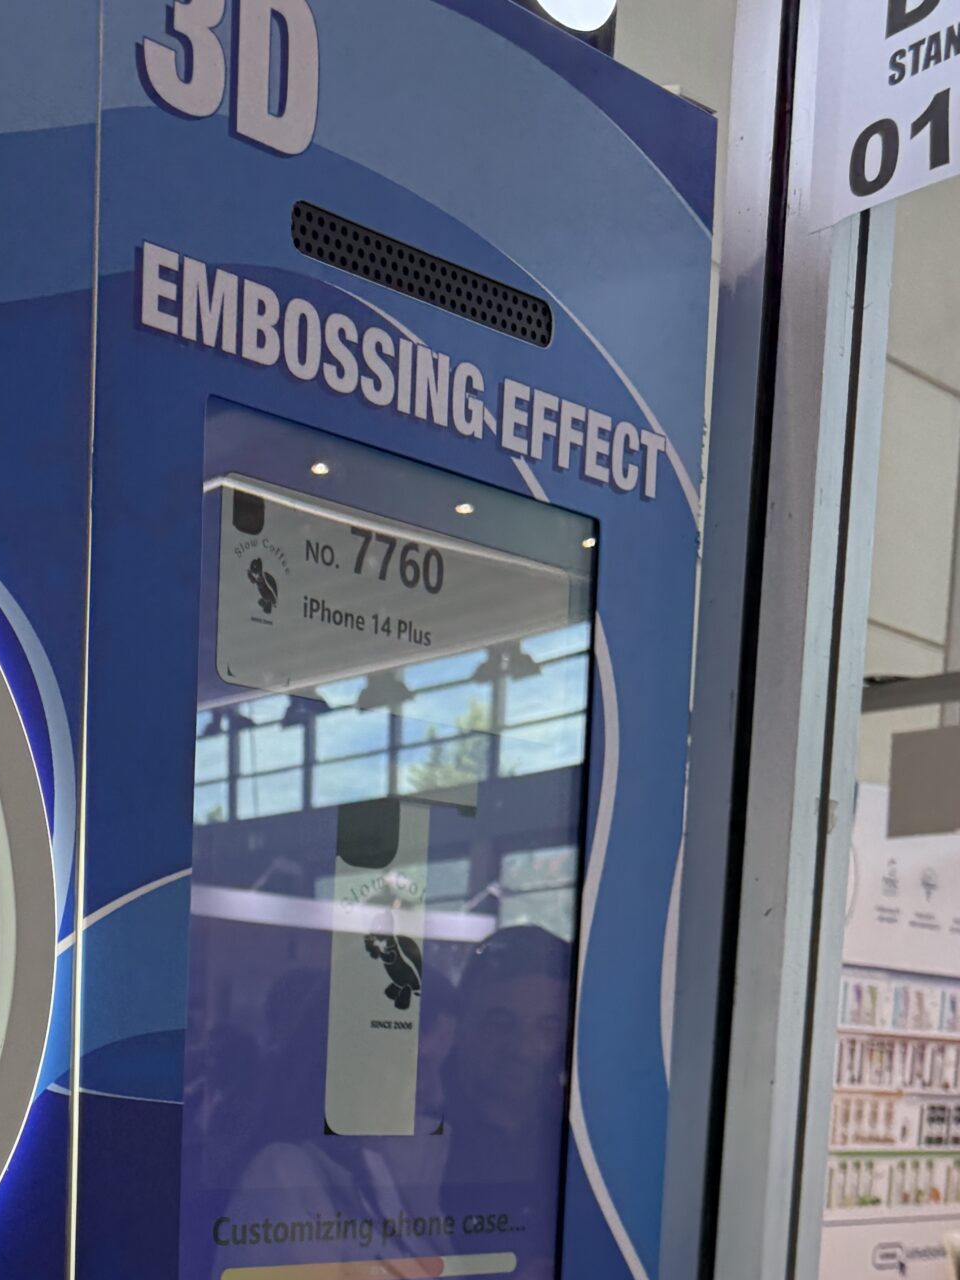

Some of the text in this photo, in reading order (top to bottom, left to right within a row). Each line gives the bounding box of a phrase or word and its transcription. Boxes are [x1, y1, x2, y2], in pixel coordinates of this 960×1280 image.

[138, 0, 321, 157] 3D
[849, 88, 951, 197] 01
[139, 241, 668, 501] EMBOSSING EFFECT
[349, 525, 445, 595] 7760
[302, 595, 432, 647] iPhone 14 Plus
[212, 1211, 374, 1247] Customizing
[381, 1209, 456, 1244] phone
